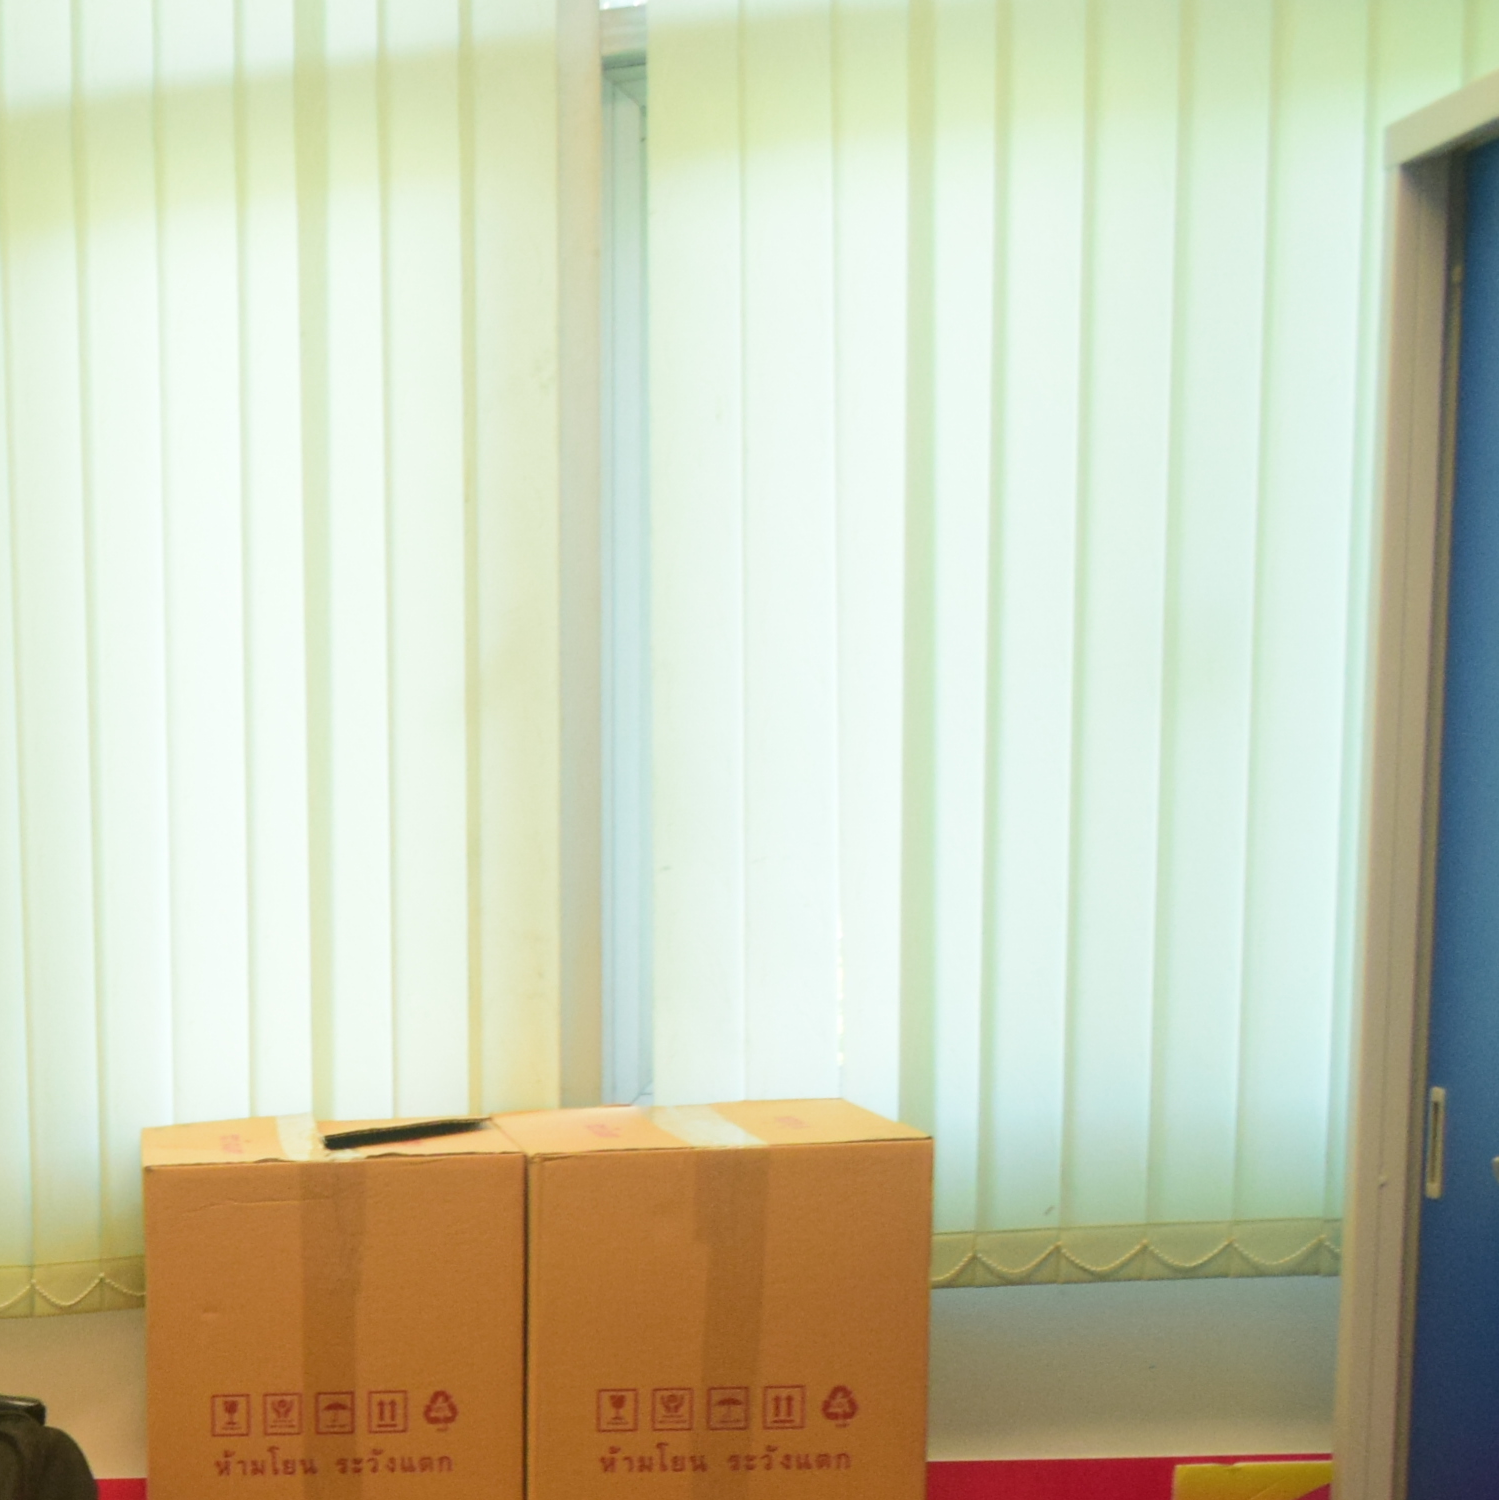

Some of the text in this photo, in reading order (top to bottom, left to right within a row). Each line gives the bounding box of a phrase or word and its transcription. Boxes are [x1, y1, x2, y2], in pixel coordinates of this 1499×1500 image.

[213, 1445, 453, 1477] ห้ามโยน ระวังแตก
[599, 1441, 853, 1474] ห้ามโยน ระวังแตก
